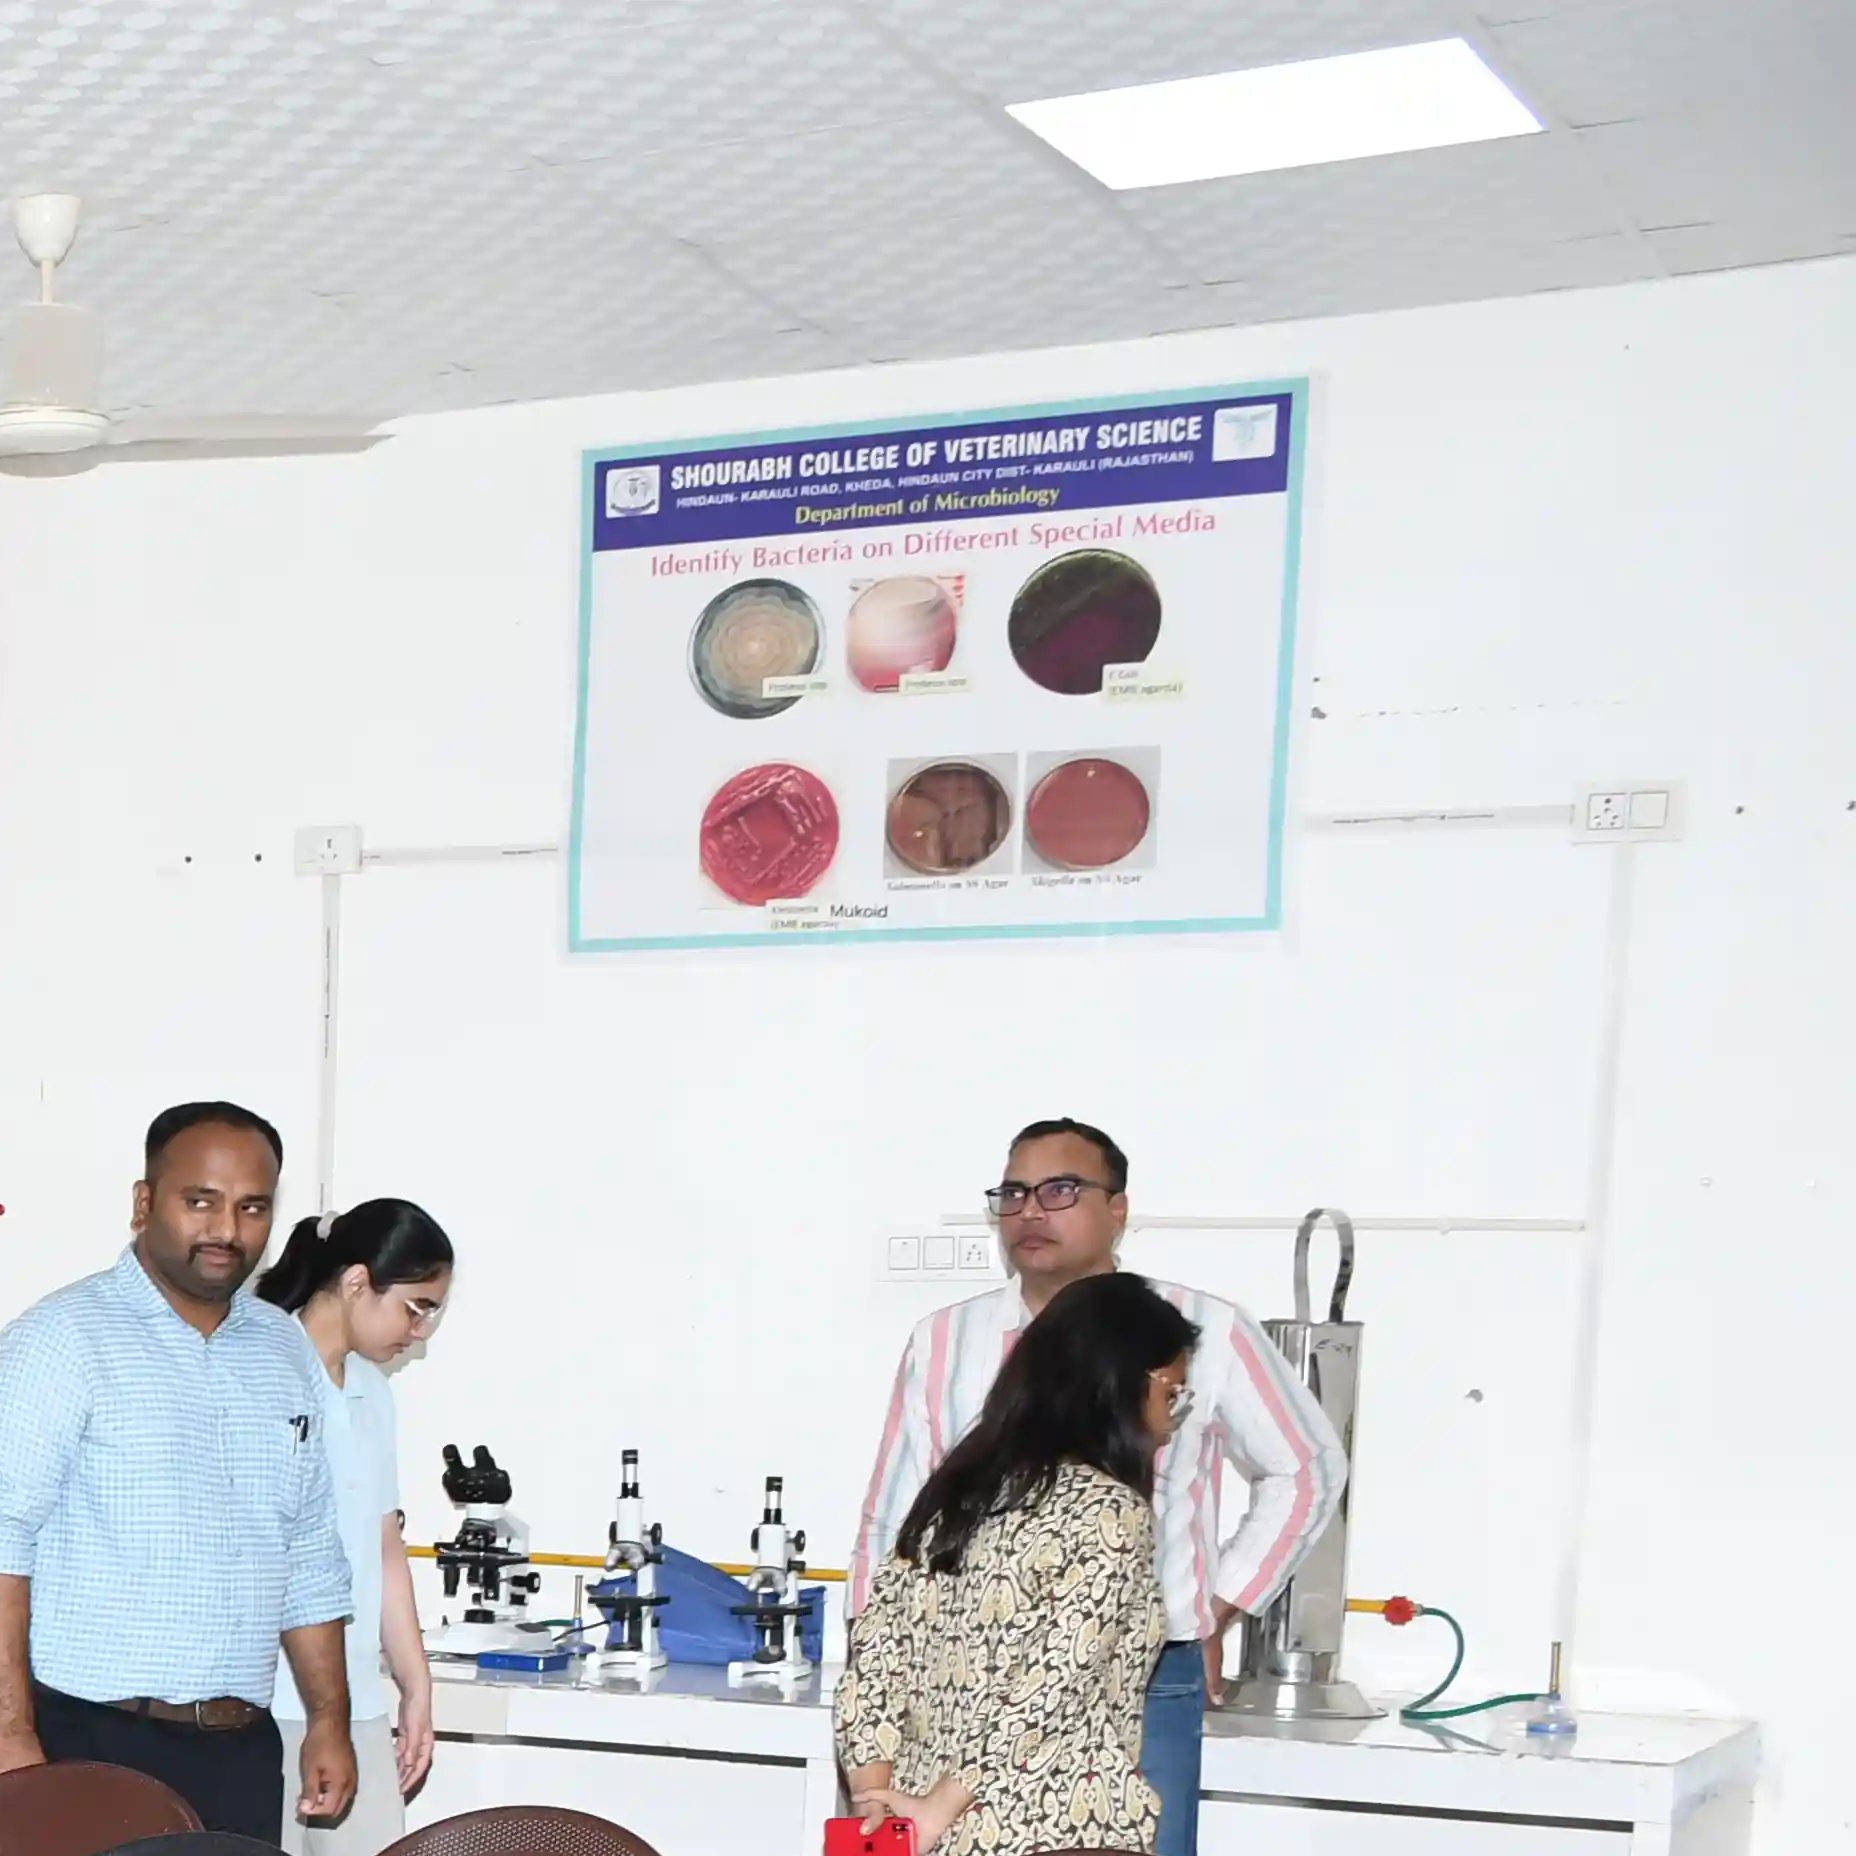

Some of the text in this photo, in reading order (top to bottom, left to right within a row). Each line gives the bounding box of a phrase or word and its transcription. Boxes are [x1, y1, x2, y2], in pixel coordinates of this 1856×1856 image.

[671, 415, 1203, 490] SHOURABH COLLEGE OF VETERINARY SCIENCE
[741, 486, 798, 503] KARAULI
[898, 470, 960, 488] HINDAUN
[962, 466, 992, 483] CITY
[1033, 458, 1096, 476] KARAULI
[1098, 449, 1194, 471] (RAJASTHAN)
[795, 485, 1061, 525] Department of Microbiology
[651, 506, 1216, 578] Identify Bacteria on Different Special Media
[830, 903, 889, 919] Mukoid
